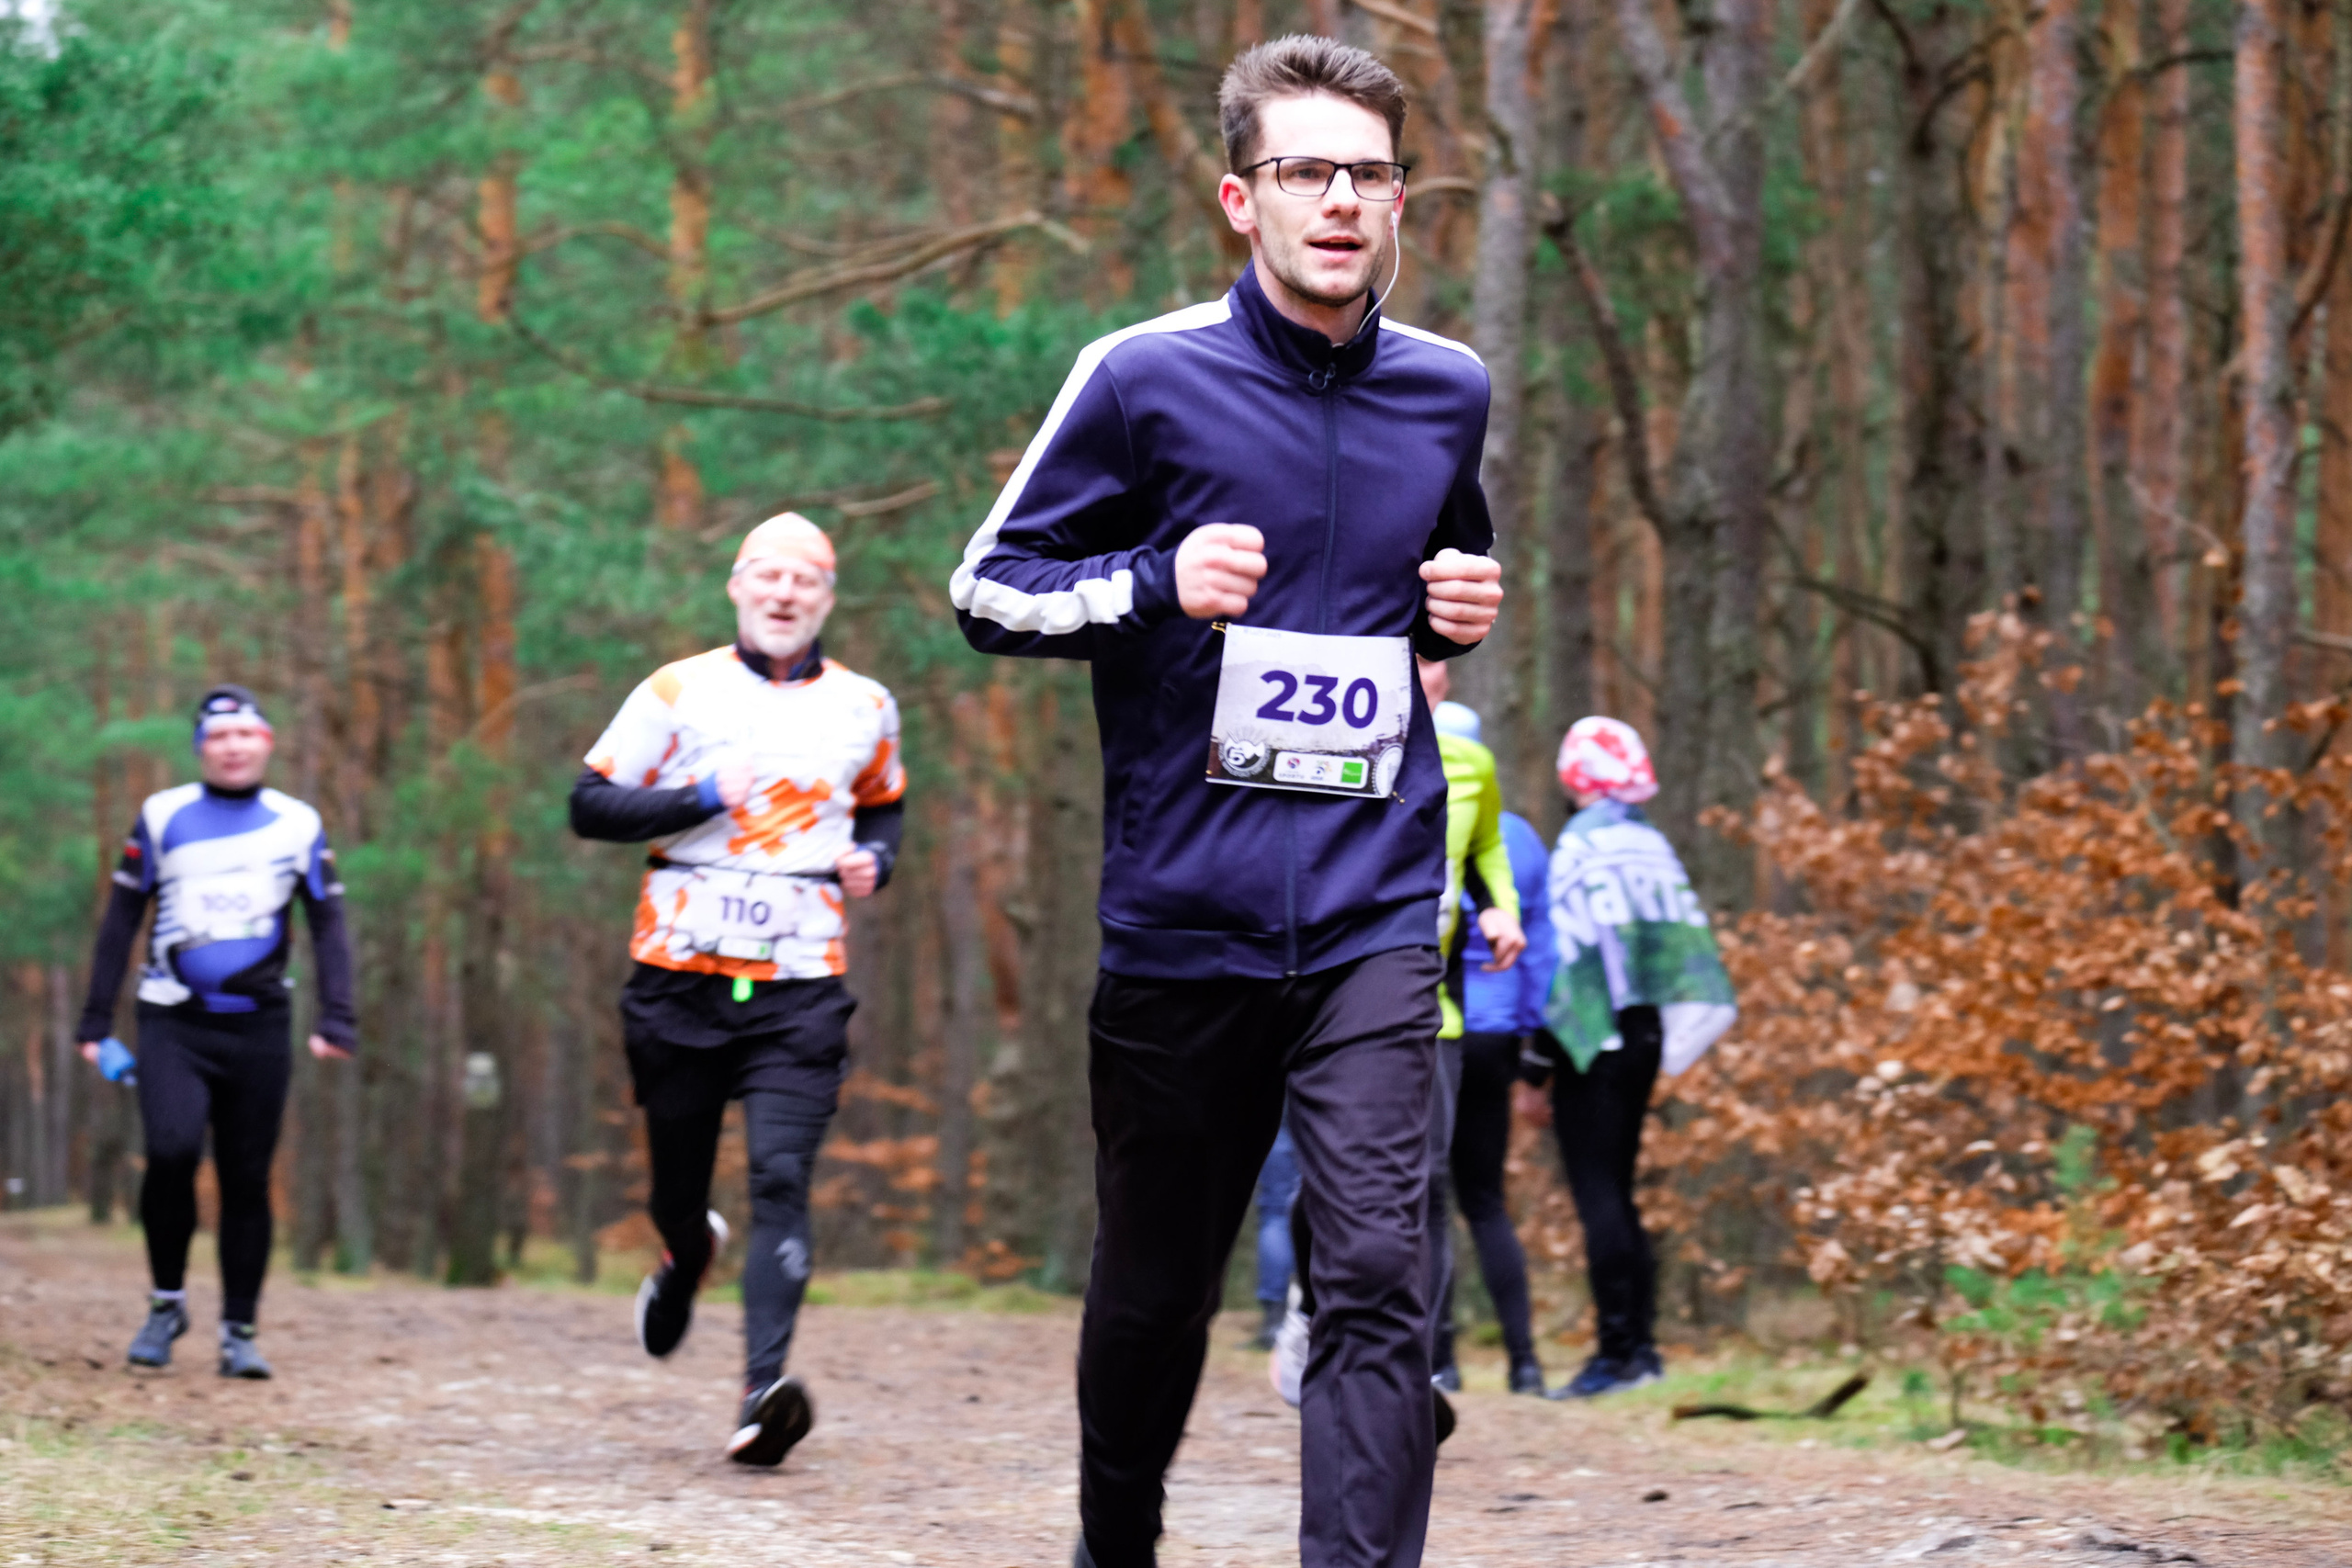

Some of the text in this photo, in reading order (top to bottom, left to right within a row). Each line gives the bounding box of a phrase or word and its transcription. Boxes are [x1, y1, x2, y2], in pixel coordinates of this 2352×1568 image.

[1256, 670, 1378, 729] 230
[200, 893, 252, 912] 100
[720, 895, 772, 926] 110
